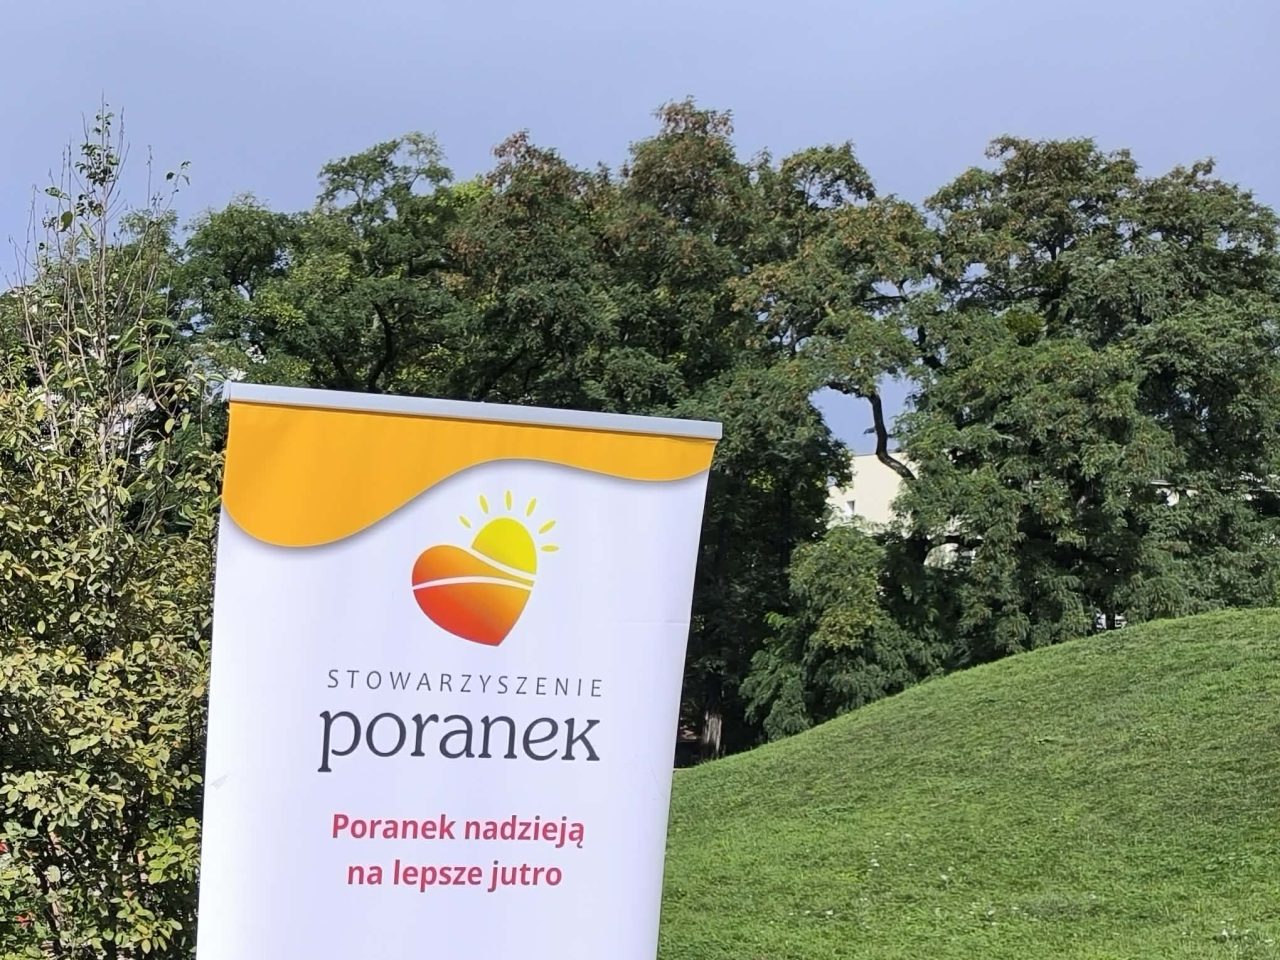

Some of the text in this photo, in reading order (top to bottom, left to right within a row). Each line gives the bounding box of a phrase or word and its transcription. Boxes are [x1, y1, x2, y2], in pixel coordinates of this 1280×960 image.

[328, 669, 603, 697] STOWARZYSZENIE
[318, 710, 600, 773] poranek
[332, 813, 585, 848] Poranek nadzieją
[348, 858, 562, 892] na lepsze jutro
